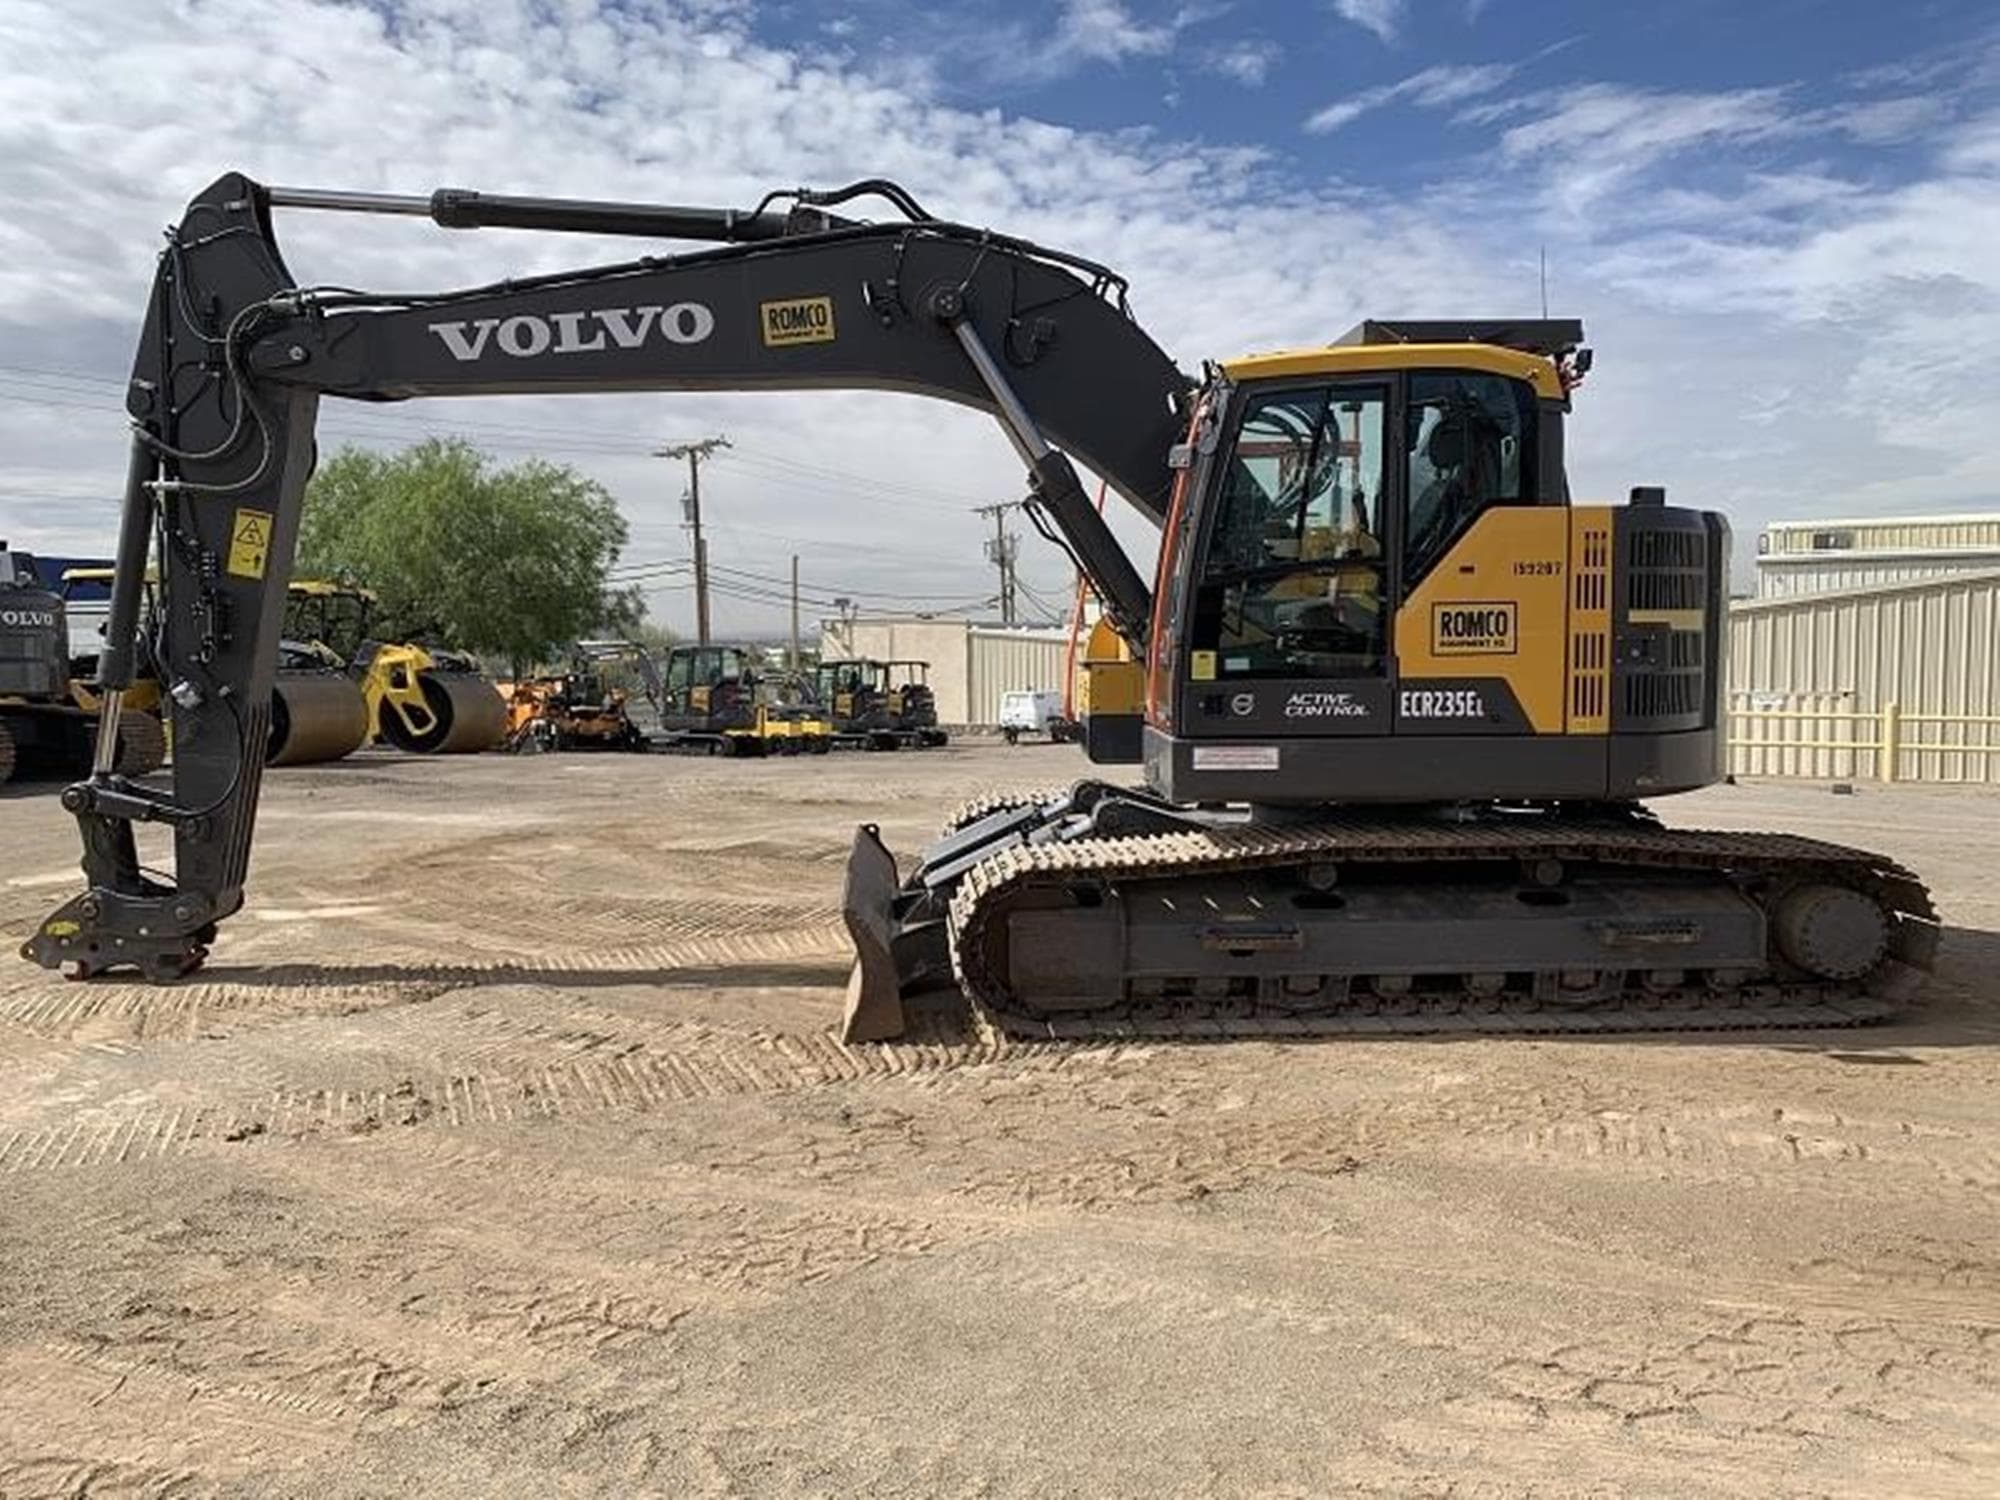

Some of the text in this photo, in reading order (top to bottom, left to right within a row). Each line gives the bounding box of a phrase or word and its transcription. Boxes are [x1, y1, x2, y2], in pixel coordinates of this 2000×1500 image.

[769, 304, 827, 331] ROMCO
[429, 302, 715, 361] VOLVO
[0, 611, 53, 626] OLVO
[1441, 610, 1508, 637] ROMCO
[1287, 693, 1353, 705] ACTIVE
[1286, 705, 1371, 718] CONTROL
